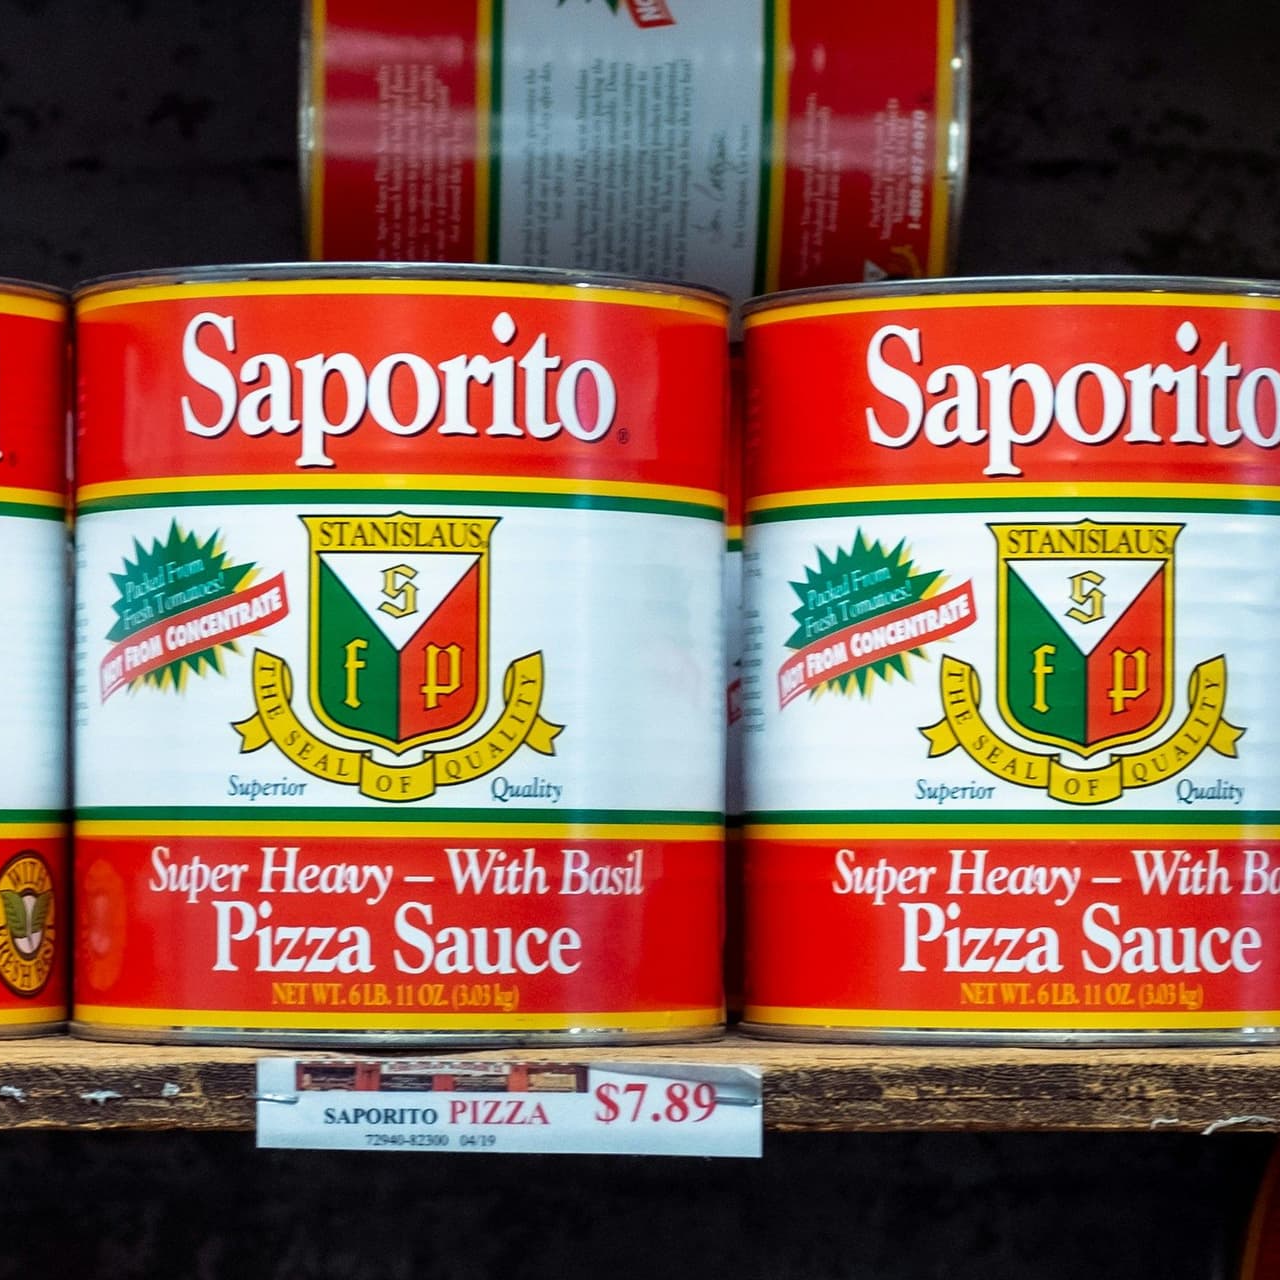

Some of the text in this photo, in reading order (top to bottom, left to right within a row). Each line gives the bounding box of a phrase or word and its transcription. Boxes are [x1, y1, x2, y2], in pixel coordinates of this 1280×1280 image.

[181, 311, 616, 468] Saporito
[319, 521, 484, 549] STANISLAUS
[1008, 529, 1168, 554] STANISLAUS
[259, 662, 536, 795] THE SEAL OF QUALITY
[228, 775, 562, 802] Superior Quality
[916, 779, 1244, 805] Superior Quality
[149, 846, 645, 904] Super Heavy With Basil
[832, 849, 936, 896] Super
[948, 850, 1080, 904] Heavy
[1133, 850, 1231, 896] With
[212, 901, 581, 975] Pizza Sauce
[899, 902, 1262, 974] Pizza Sauce
[272, 982, 520, 1010] NET WT. 6 LB. 11 OZ. (3.03 kg)
[324, 1082, 718, 1125] SAPORITO PIZZA $7.89
[365, 1134, 495, 1147] 72940-82300 04/19
